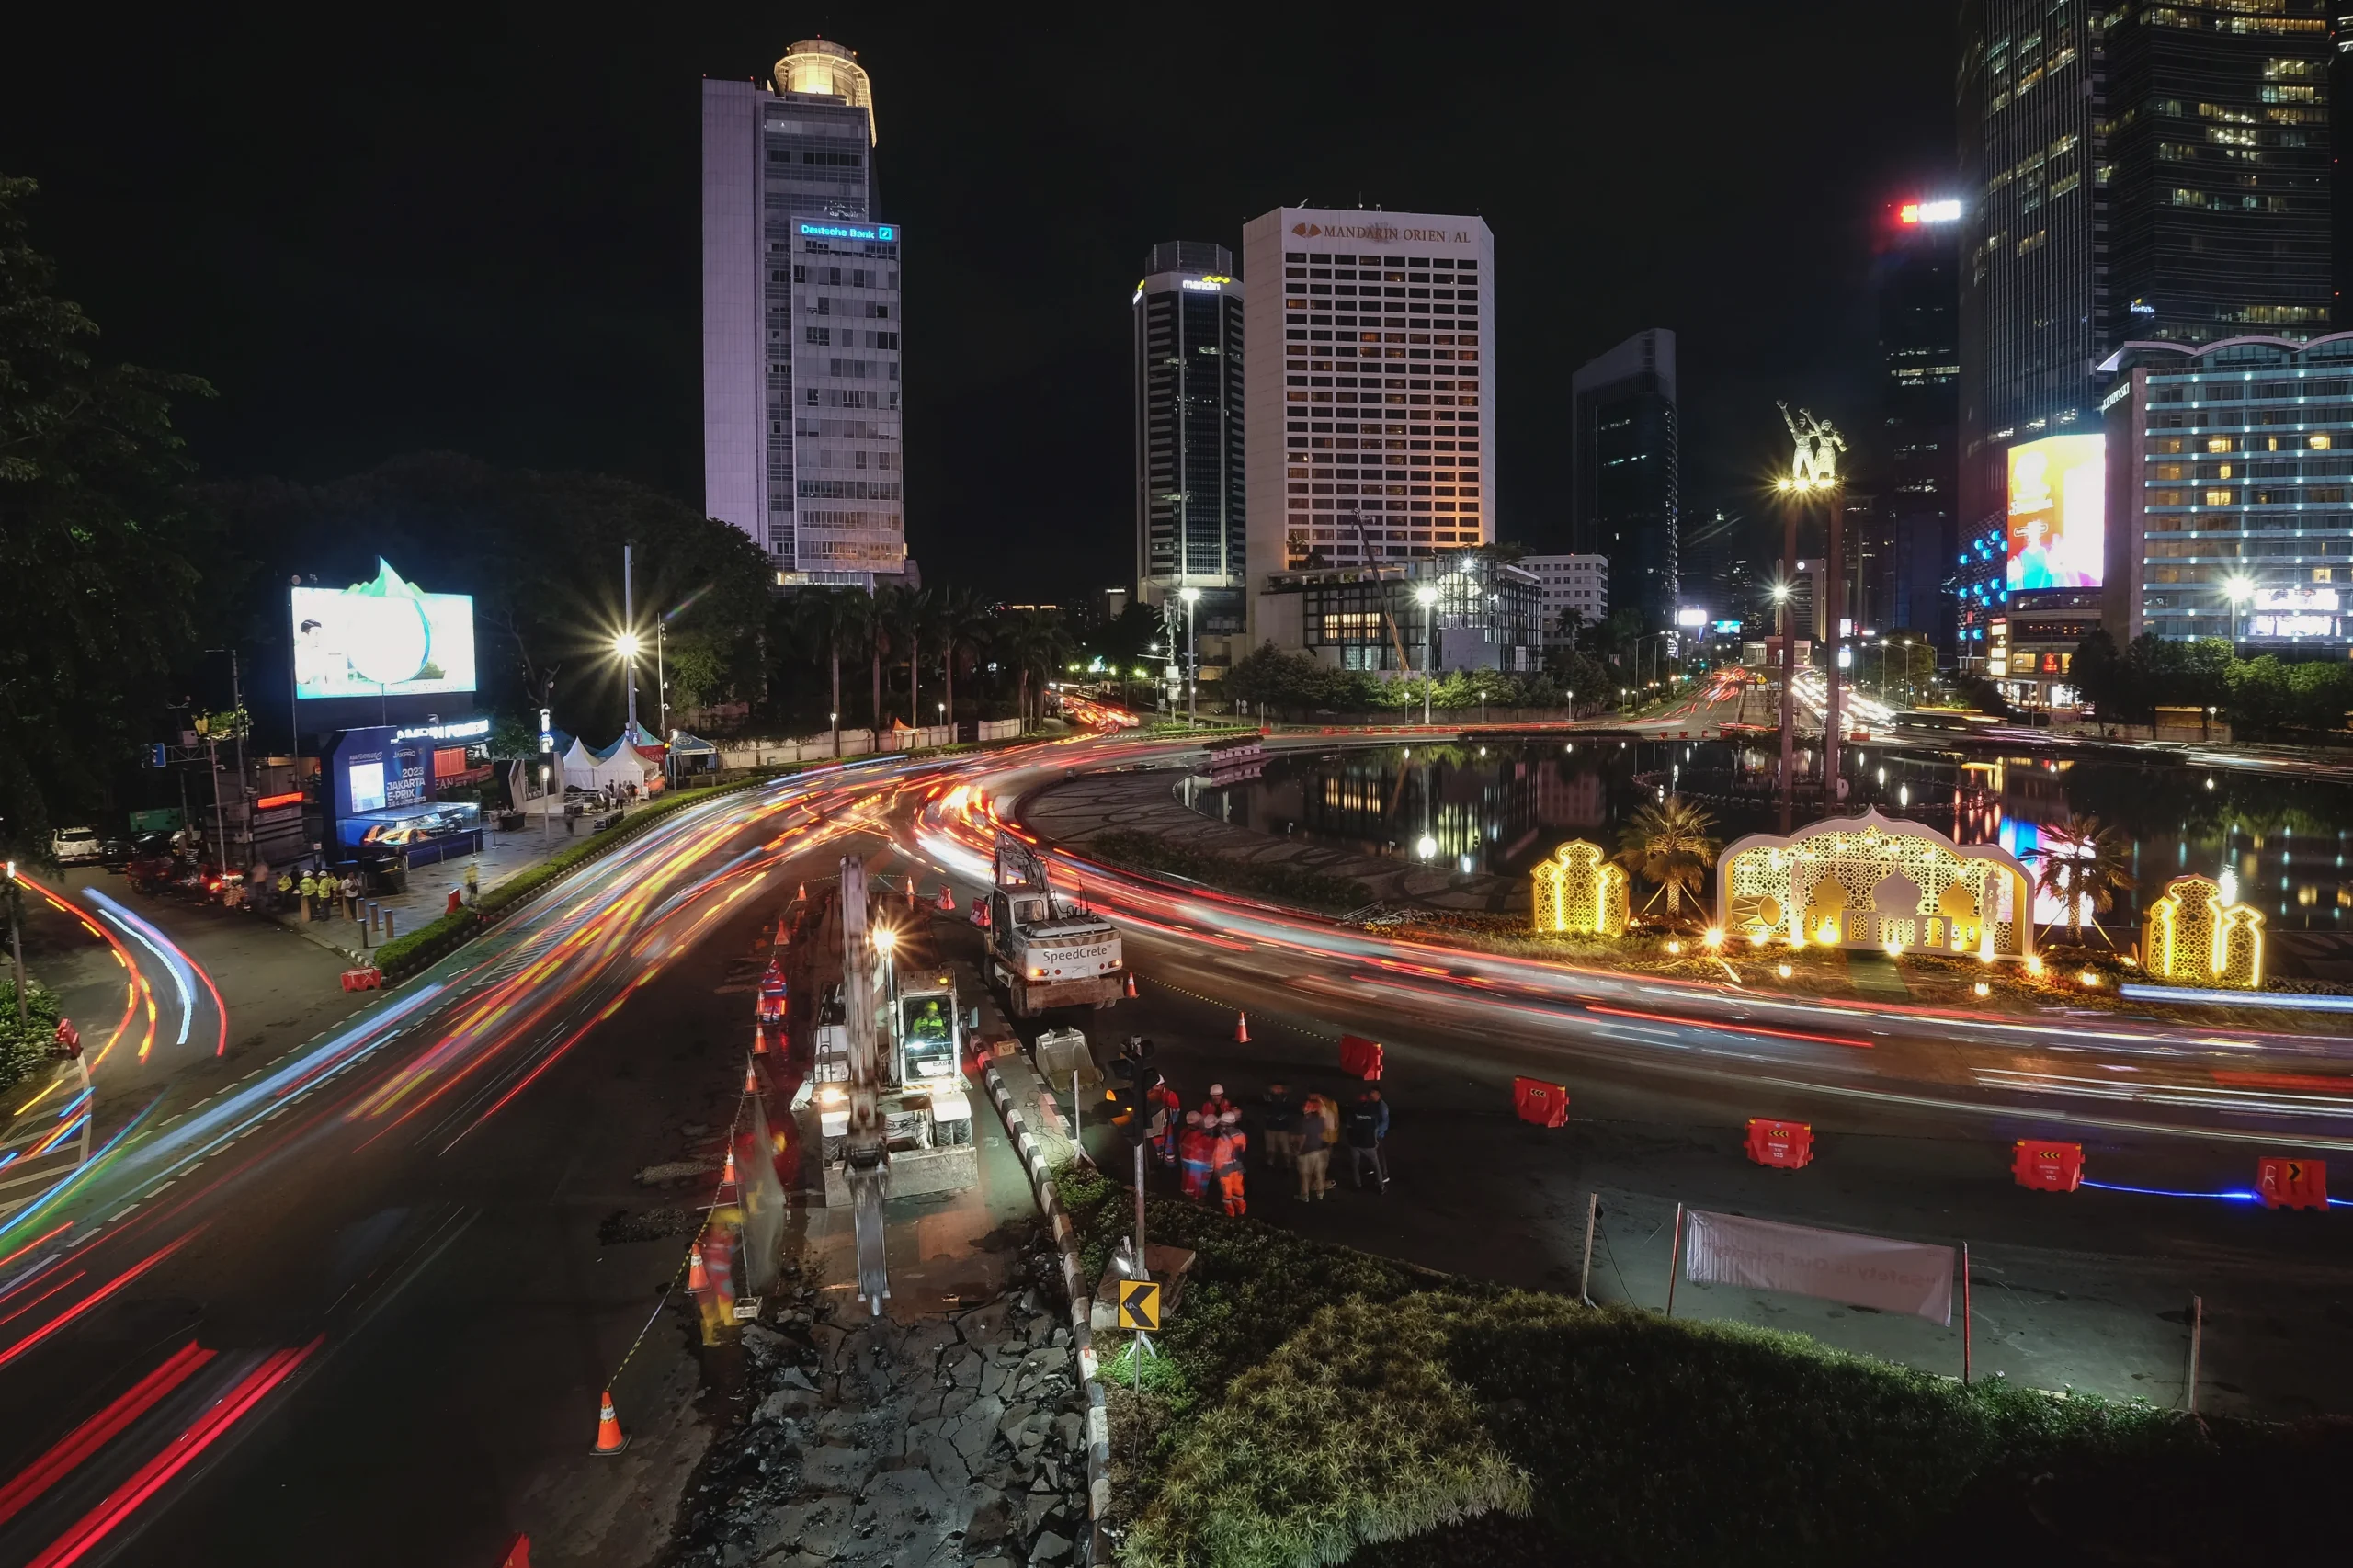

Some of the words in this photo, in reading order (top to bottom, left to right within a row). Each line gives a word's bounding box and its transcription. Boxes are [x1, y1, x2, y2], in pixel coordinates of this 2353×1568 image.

[801, 225, 847, 237] Deutsche
[849, 228, 875, 239] Bank
[1324, 226, 1398, 240] MANDARIN
[1404, 229, 1471, 243] ORIENAL
[402, 767, 425, 778] 2023
[386, 778, 426, 791] JAKARTA
[387, 789, 415, 801] E-PRIX
